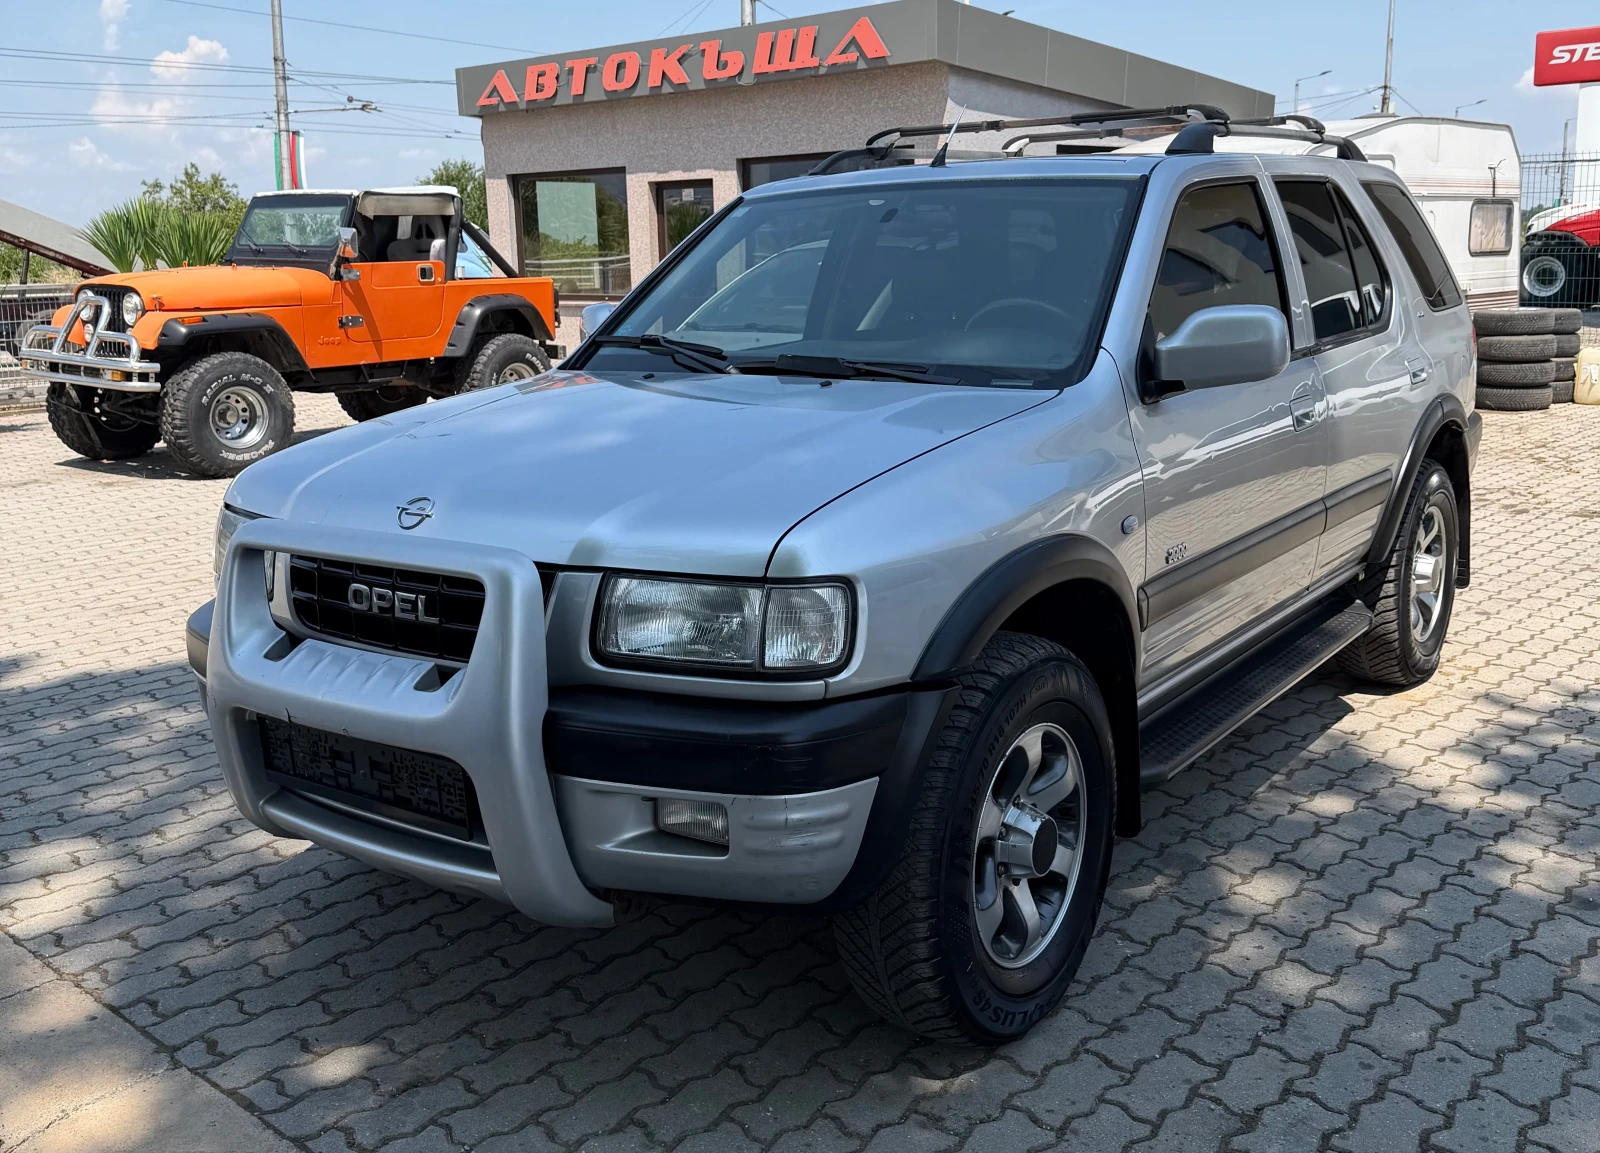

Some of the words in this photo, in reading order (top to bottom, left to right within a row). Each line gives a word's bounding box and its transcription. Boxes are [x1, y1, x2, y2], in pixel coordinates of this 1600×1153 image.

[475, 16, 891, 107] АВТОКЪЩА
[317, 335, 342, 348] Jeep
[201, 374, 236, 406] RADIAL
[1165, 542, 1188, 564] 2000
[347, 583, 440, 624] OPEL
[1004, 695, 1027, 727] 107H
